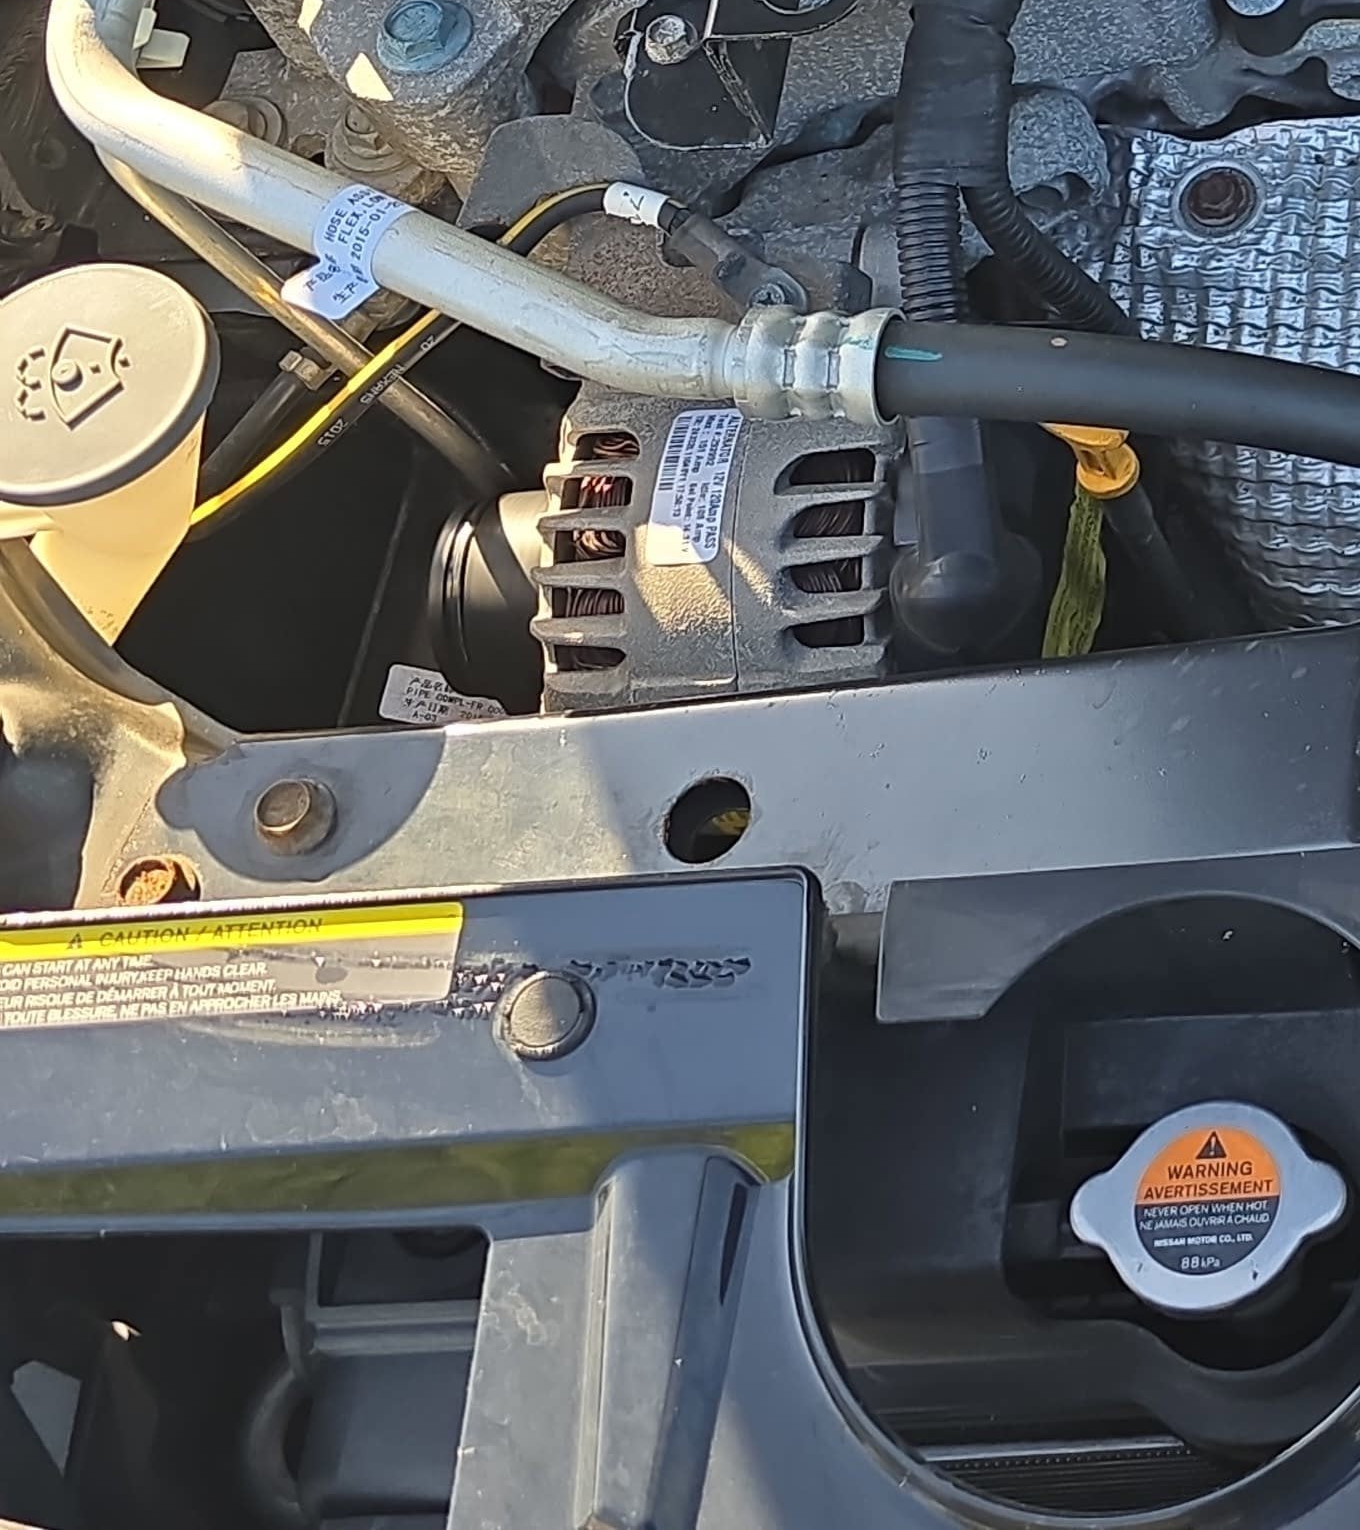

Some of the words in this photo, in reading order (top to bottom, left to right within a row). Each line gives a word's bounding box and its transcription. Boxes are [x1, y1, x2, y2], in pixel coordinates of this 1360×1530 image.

[324, 208, 348, 243] HOSE
[318, 418, 348, 446] 2015
[717, 415, 741, 465] ALTERNATOR
[713, 471, 725, 487] 12V
[704, 525, 717, 549] PASS
[406, 687, 431, 699] PIPE
[100, 928, 190, 947] CAUTION
[212, 918, 322, 939] ATTENTION
[23, 974, 93, 991] PERSONAL
[175, 964, 222, 980] HANDS
[223, 962, 268, 978] CLEAR.
[32, 959, 73, 975] START
[74, 959, 91, 971] AT
[91, 958, 122, 970] ANY
[24, 992, 75, 1011] RISQUE
[75, 991, 95, 1005] DE
[96, 985, 168, 1002] DÉMARRER
[182, 983, 216, 997] TOUT
[218, 979, 276, 996] MOMENT.
[120, 1004, 140, 1019] NE
[140, 1002, 168, 1017] PAS
[169, 1000, 188, 1015] EN
[190, 995, 272, 1013] APPROCHER
[273, 993, 298, 1007] LES
[1167, 1160, 1252, 1180] WARNING
[1143, 1179, 1272, 1200] AVERTISSEMENT
[1143, 1204, 1178, 1218] NEVER
[1180, 1203, 1210, 1216] OPEN
[1211, 1202, 1244, 1214] WHEN
[1246, 1200, 1268, 1210] HOT
[1140, 1218, 1153, 1230] NE
[1154, 1216, 1188, 1230] JAMAIS
[1189, 1214, 1227, 1227] OUVRIR
[1234, 1212, 1270, 1224] CHAUD
[1153, 1238, 1186, 1248] NISSAN
[1187, 1235, 1218, 1246] MOTOR
[1181, 1256, 1200, 1270] 88
[1200, 1257, 1220, 1268] kPa
